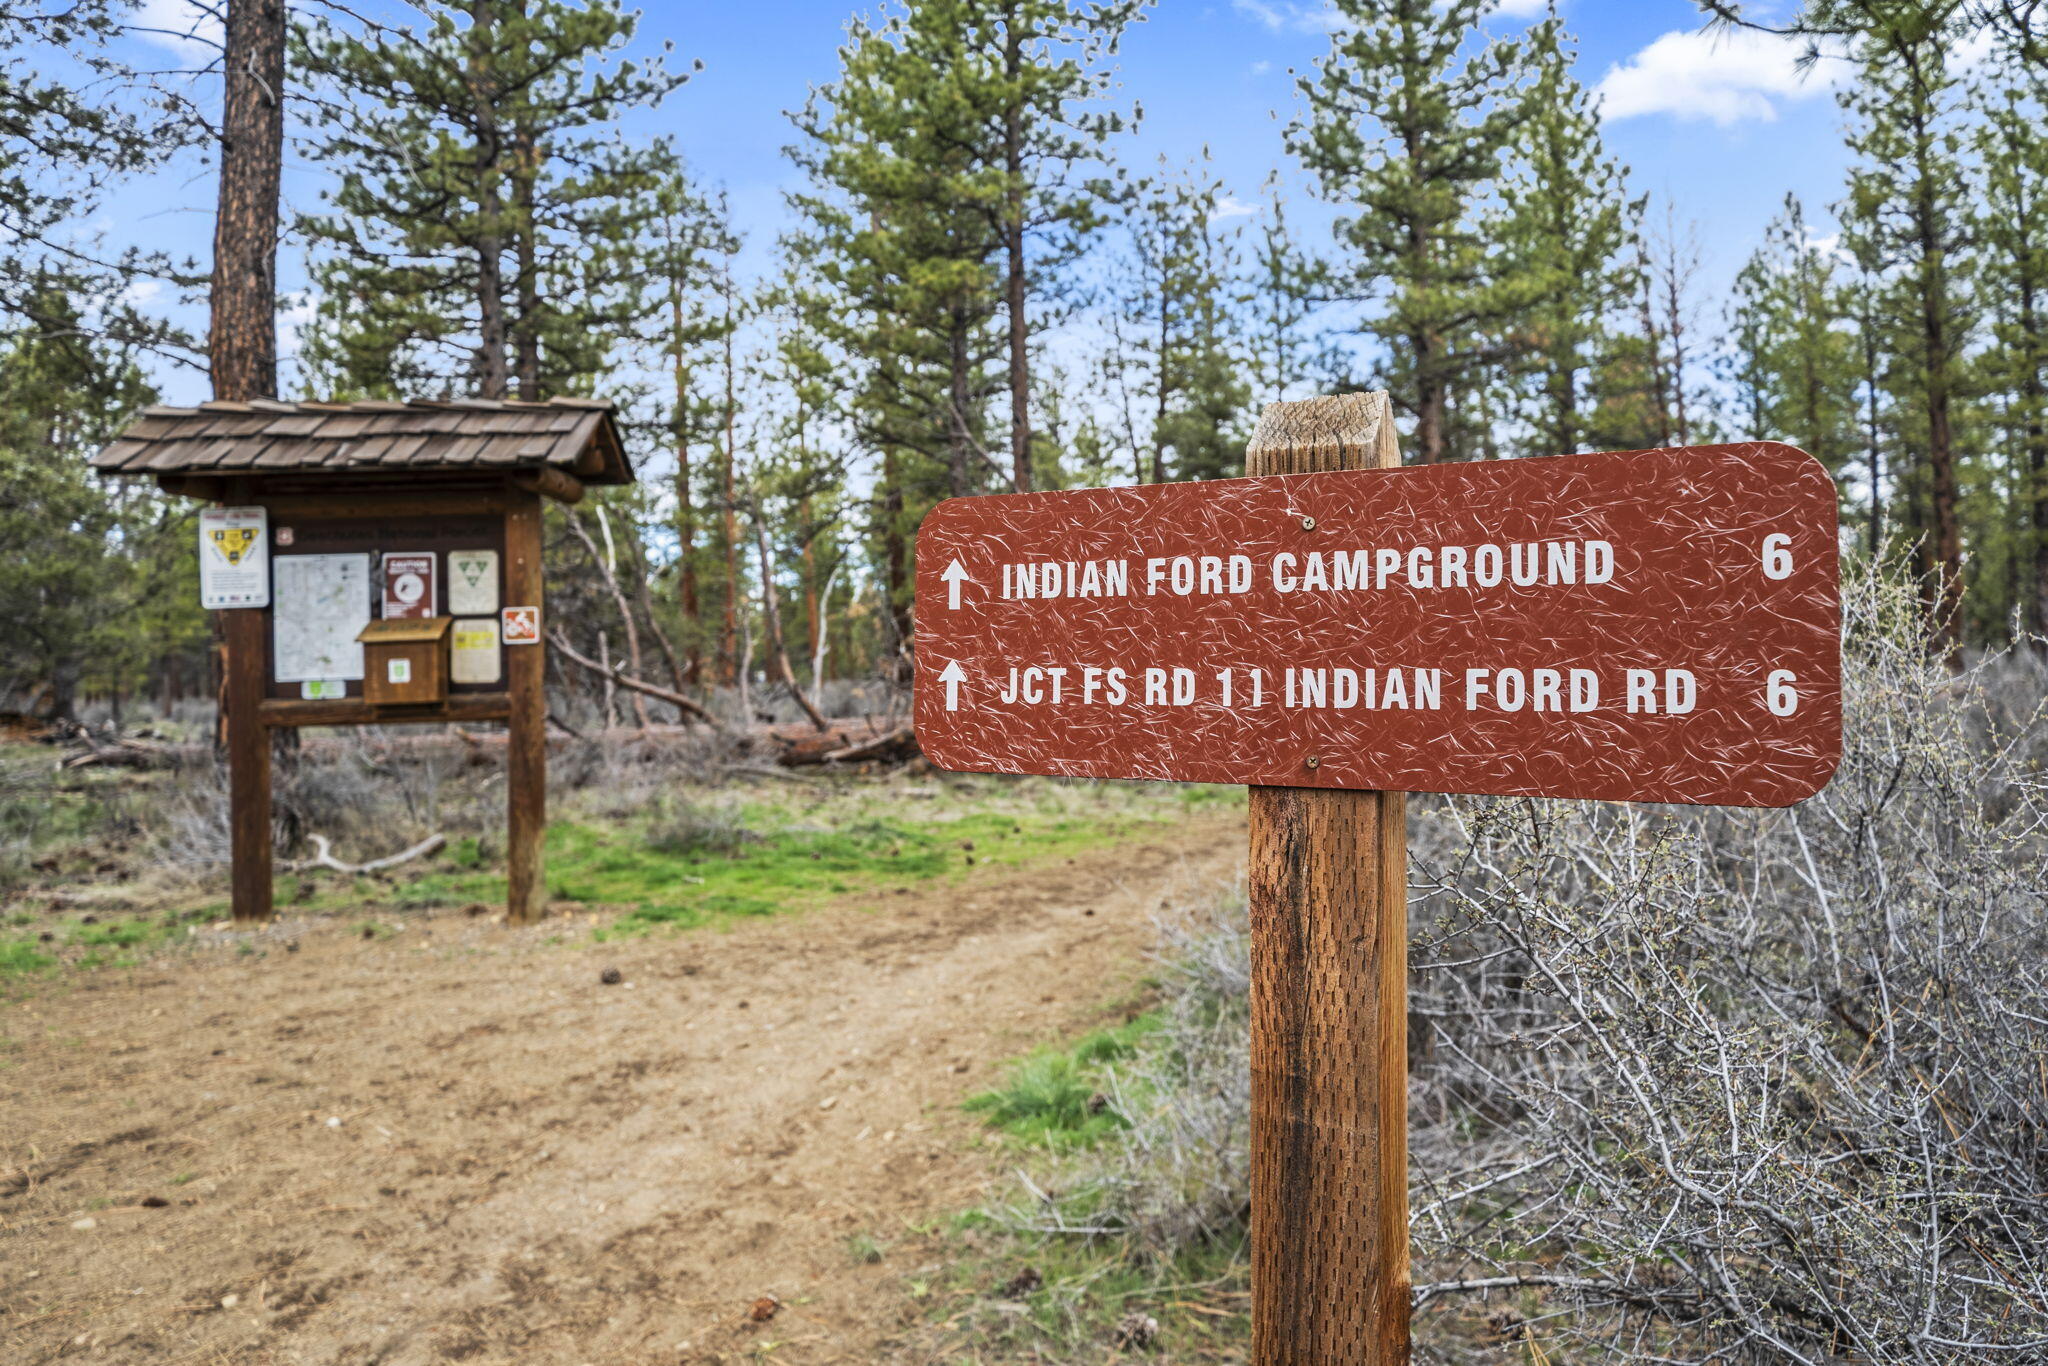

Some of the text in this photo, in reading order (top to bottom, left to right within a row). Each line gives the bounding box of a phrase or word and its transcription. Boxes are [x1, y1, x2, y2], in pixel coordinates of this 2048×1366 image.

[1002, 533, 1795, 600] INDIAN FORD CAMPGROUND 6
[1000, 667, 1798, 717] JCT FS RD 11 INDIAN FORD RD 6
